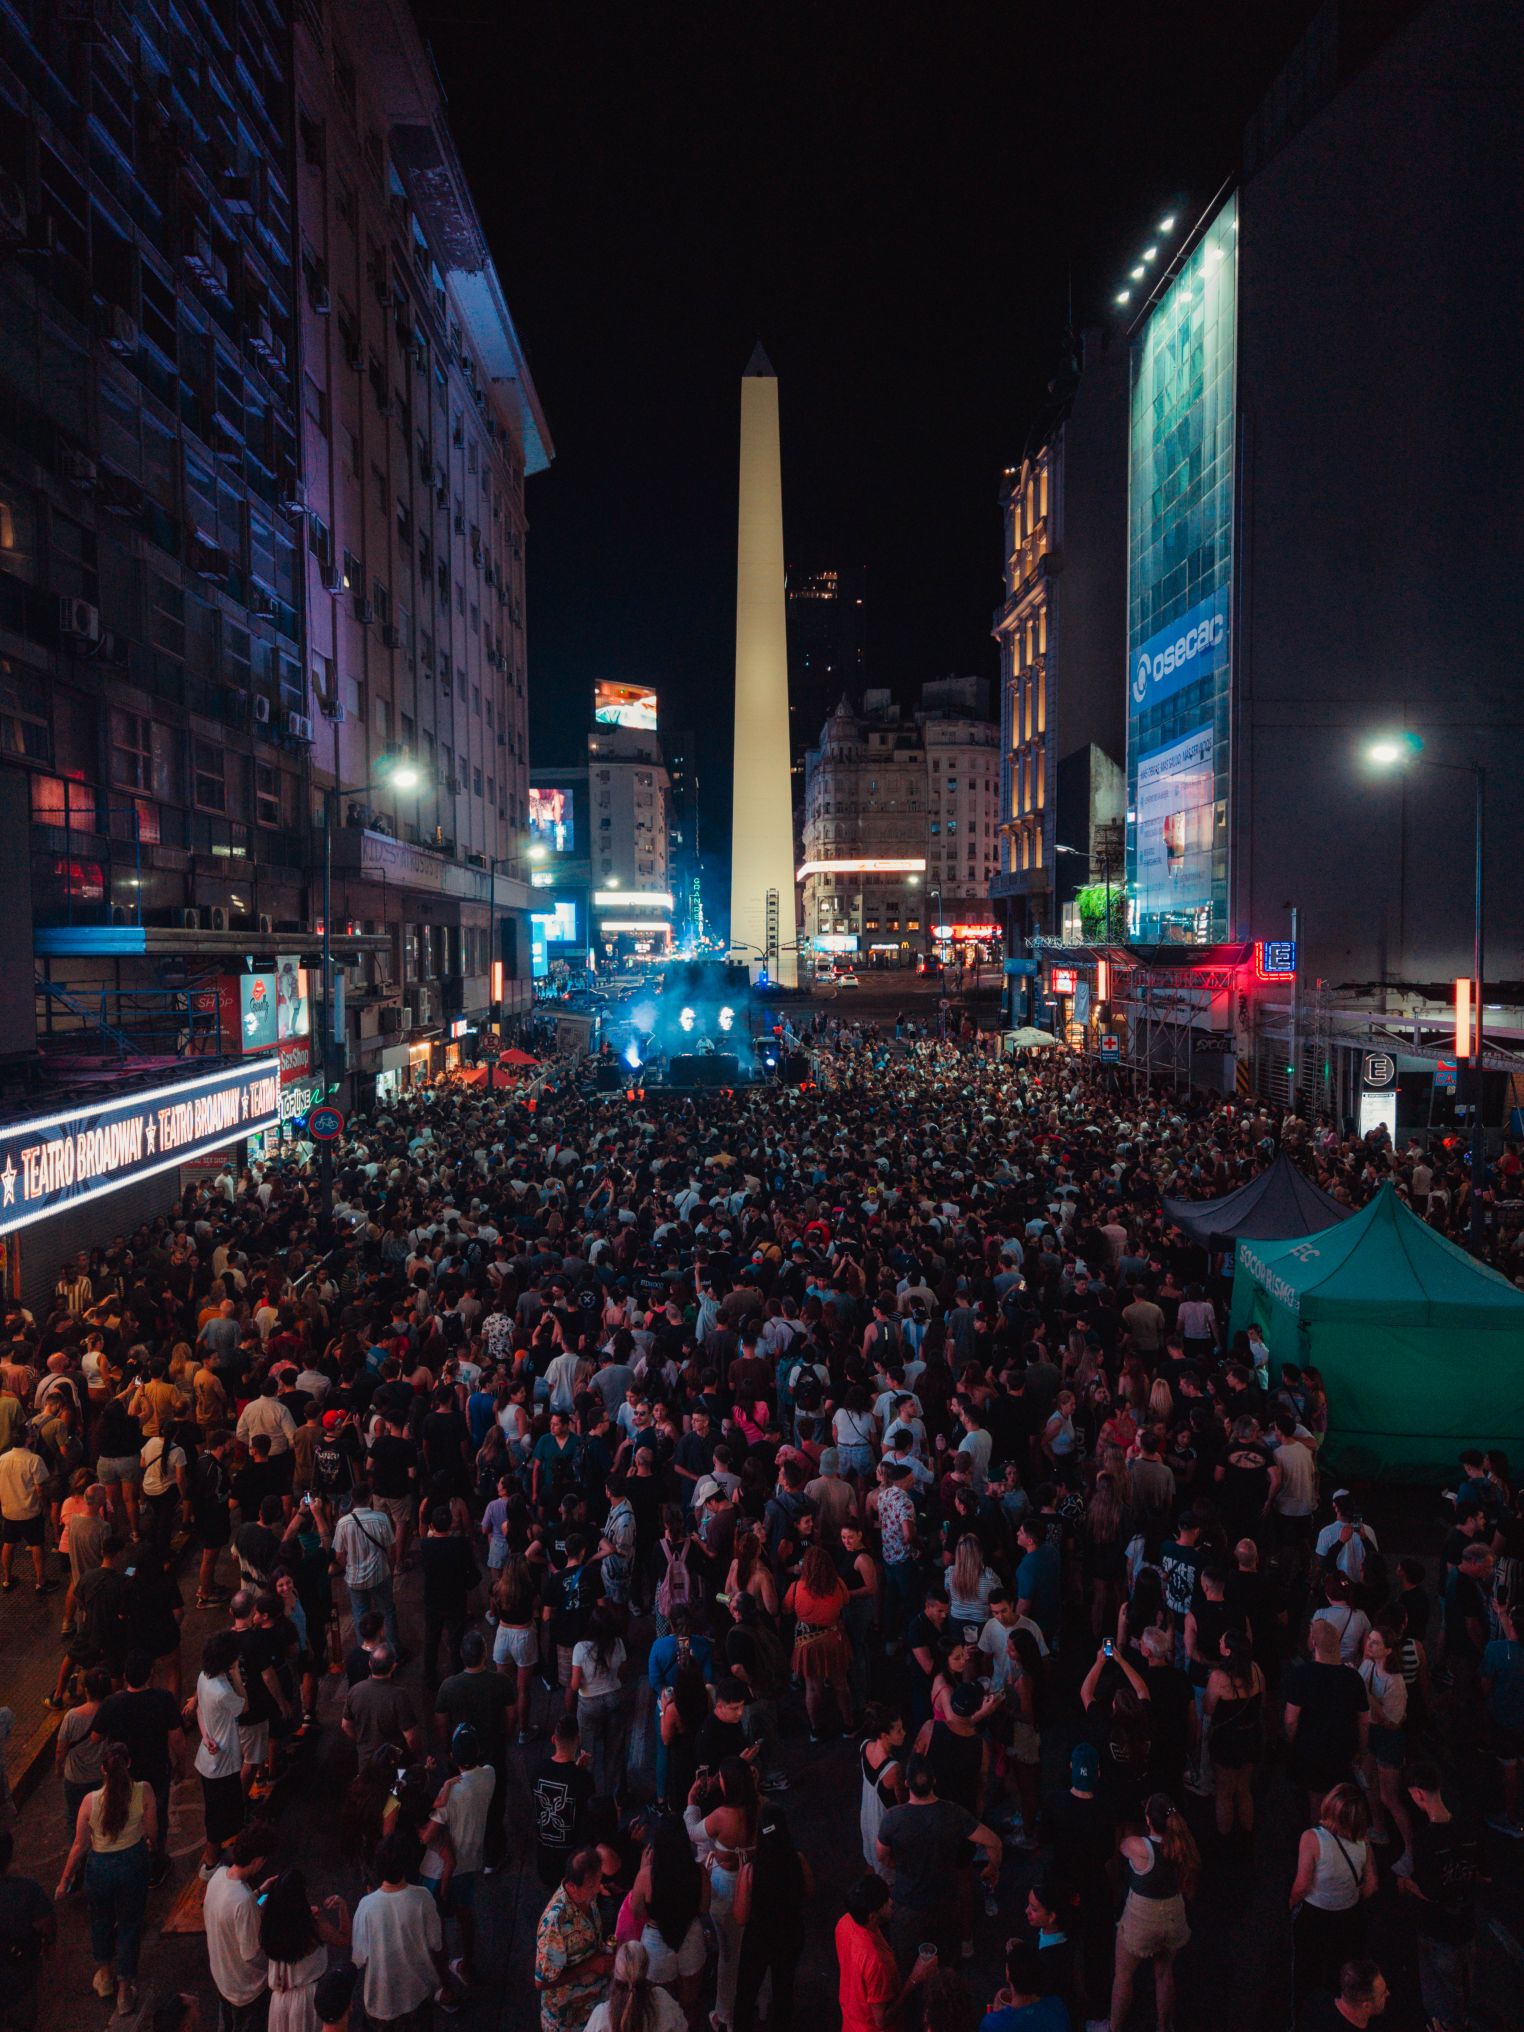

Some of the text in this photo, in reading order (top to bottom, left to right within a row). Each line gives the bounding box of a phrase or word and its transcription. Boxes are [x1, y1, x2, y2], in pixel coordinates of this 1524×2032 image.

[1153, 613, 1224, 682] osecac
[693, 877, 701, 904] GRAN
[1269, 944, 1291, 969] E
[1369, 1059, 1387, 1080] E
[22, 1076, 275, 1200] TEATRO BROADWAY TEATRO BROADWAY TEATRO
